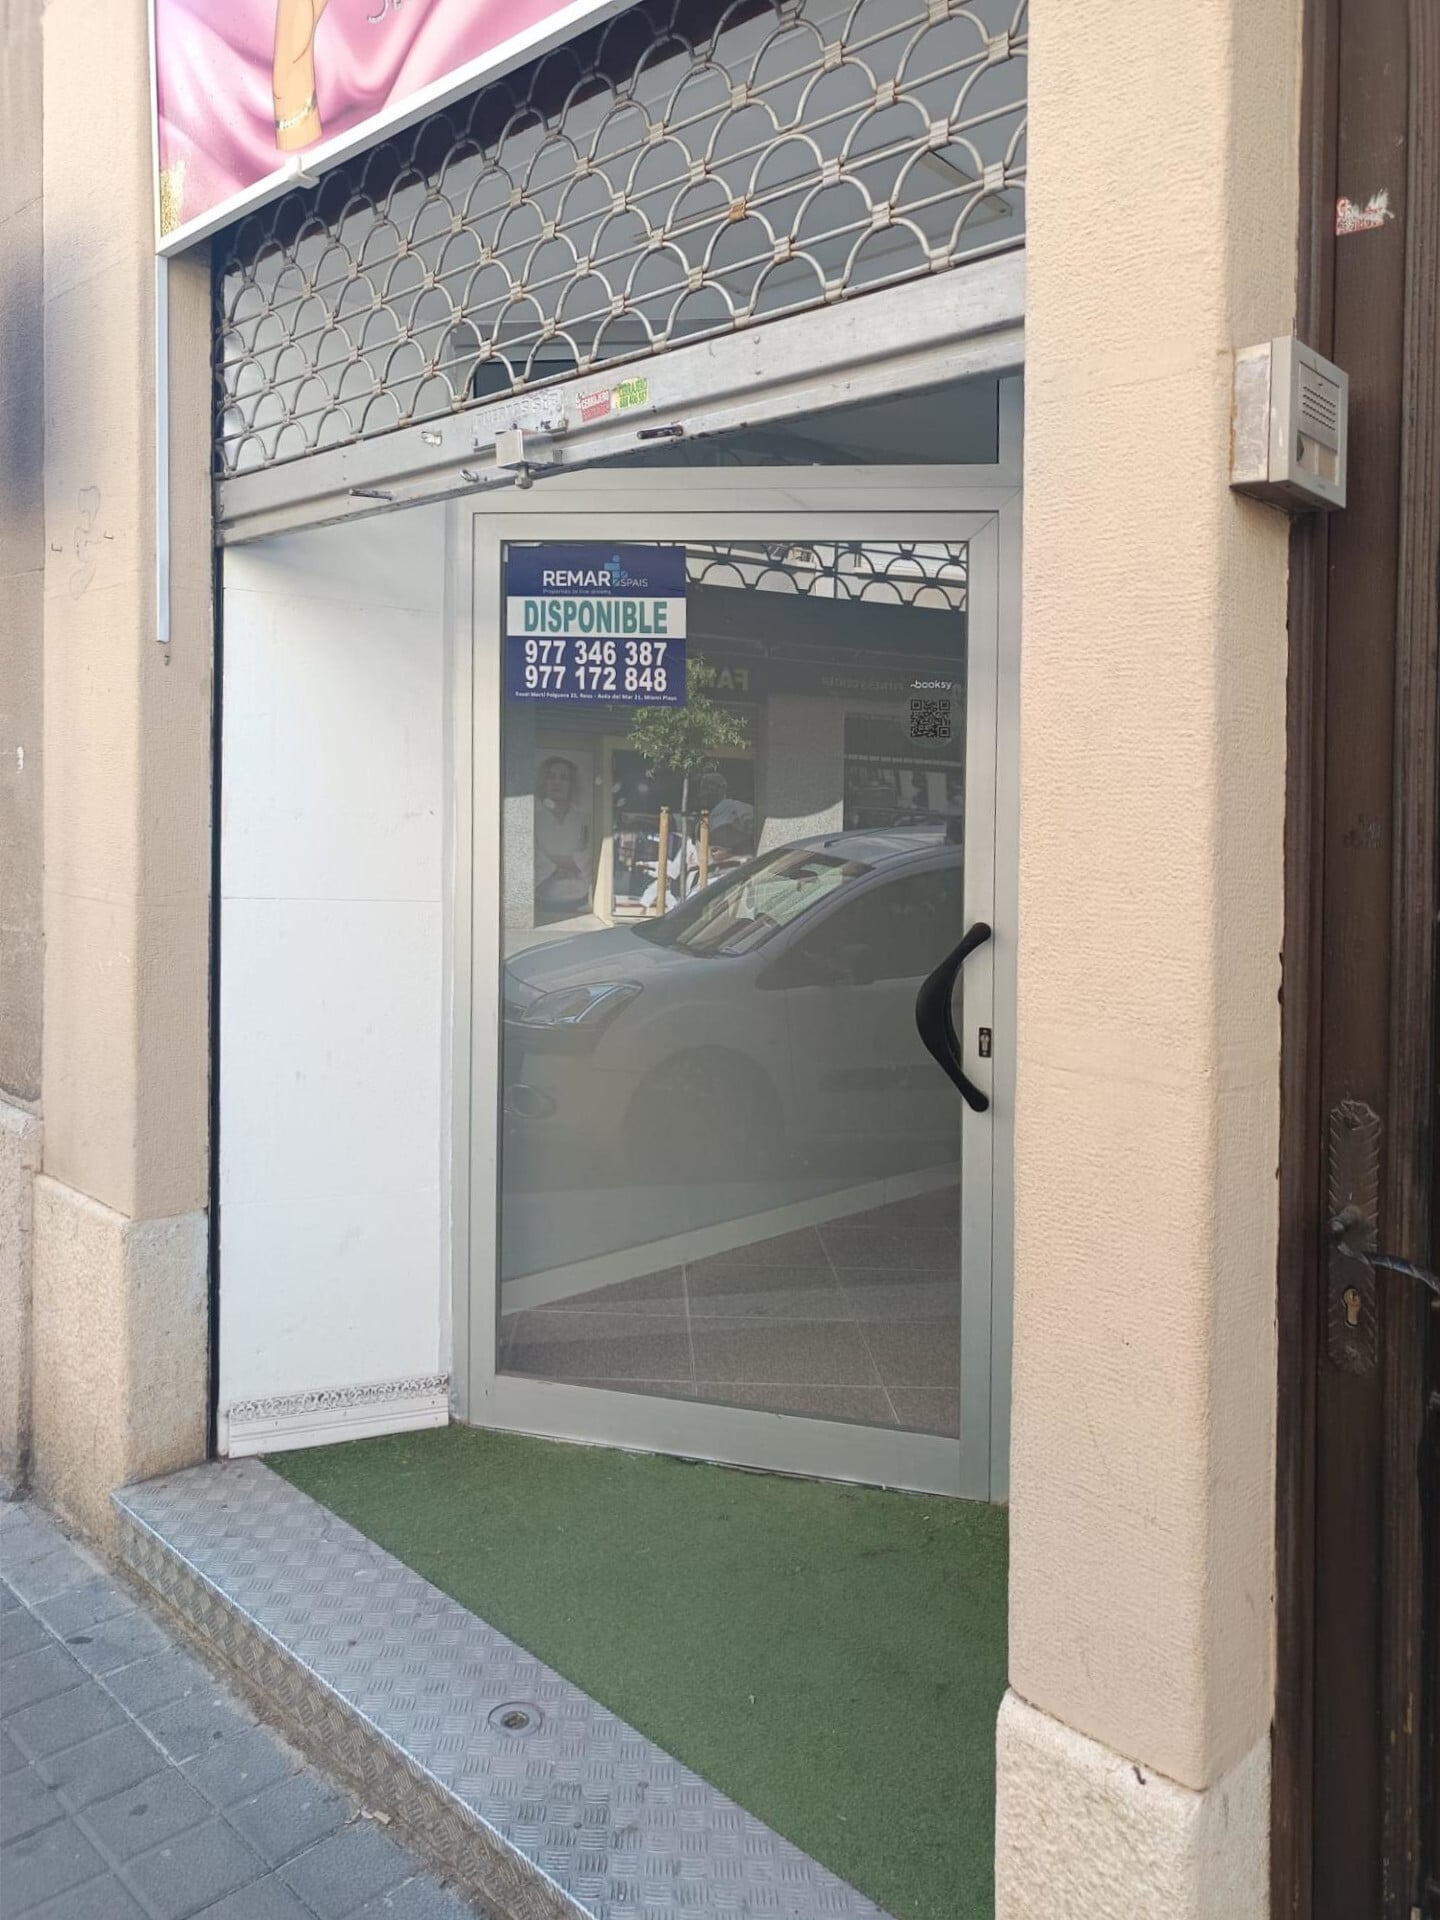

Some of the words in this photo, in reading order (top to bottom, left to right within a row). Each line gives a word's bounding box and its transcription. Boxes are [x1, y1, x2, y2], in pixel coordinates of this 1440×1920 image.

[543, 570, 611, 587] REMAR
[524, 600, 668, 634] DISPONIBLE
[525, 640, 566, 664] 977
[574, 641, 617, 665] 346
[625, 641, 667, 666] 387
[525, 665, 566, 689] 977
[575, 666, 617, 690] 172
[624, 667, 667, 692] 848
[911, 680, 952, 690] booksy
